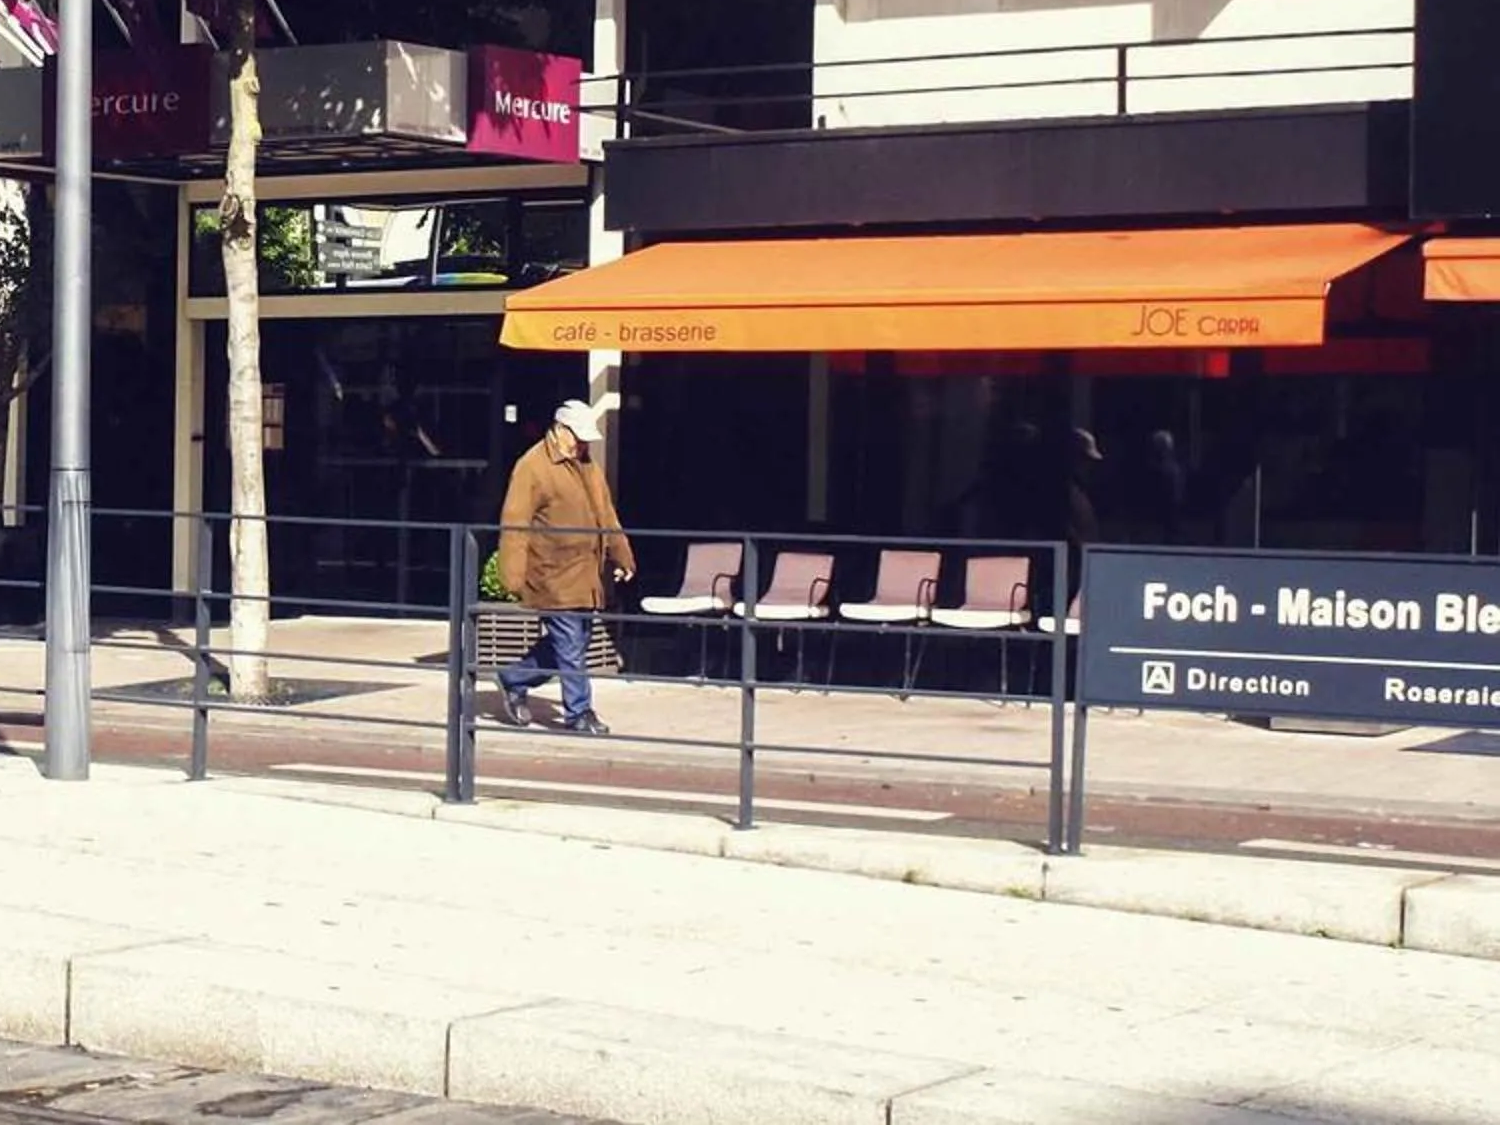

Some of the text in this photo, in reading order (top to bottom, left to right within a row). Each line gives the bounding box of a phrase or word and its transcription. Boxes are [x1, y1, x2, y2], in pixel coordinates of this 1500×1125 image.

[90, 91, 181, 118] ercure
[494, 89, 572, 125] Mercure
[553, 322, 597, 342] café
[619, 323, 718, 342] brasserie
[1130, 304, 1190, 337] JOE
[1143, 582, 1500, 635] Foch - Maison Ble
[1145, 663, 1172, 692] A
[1188, 667, 1310, 697] Direction
